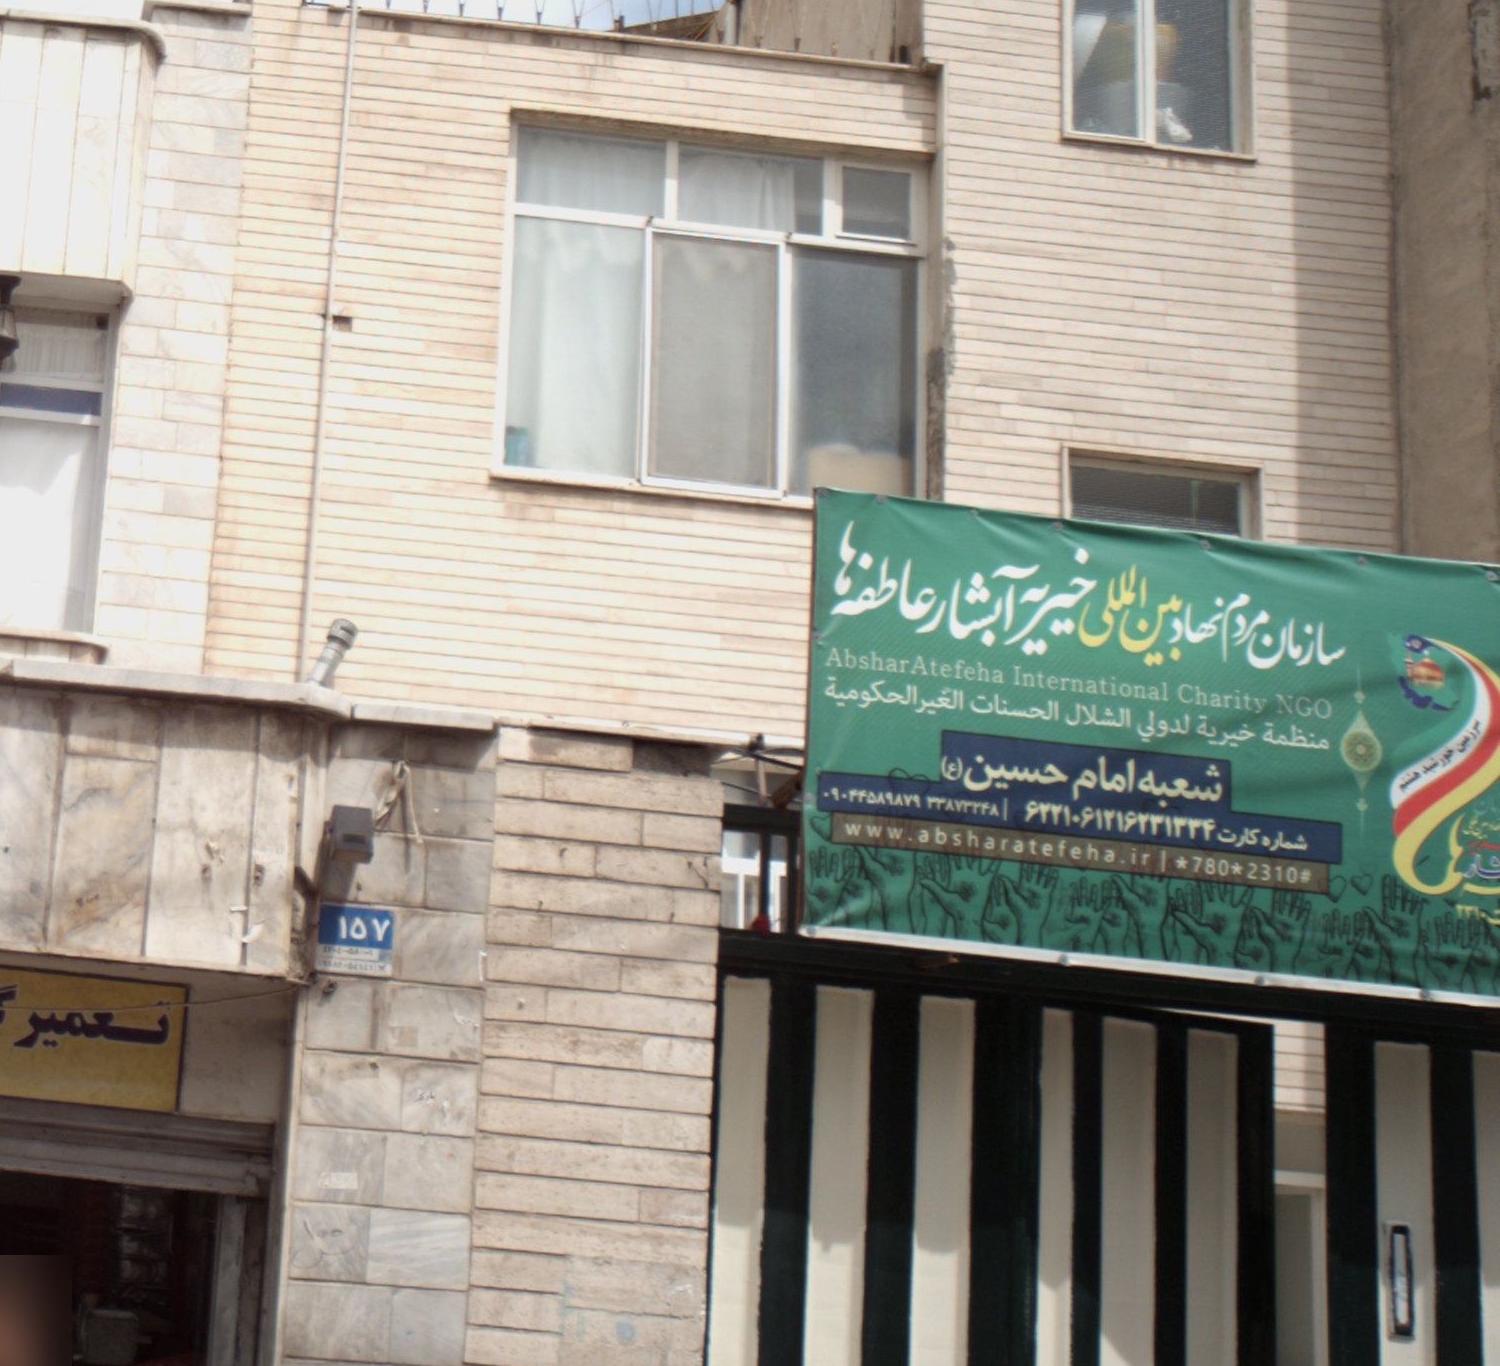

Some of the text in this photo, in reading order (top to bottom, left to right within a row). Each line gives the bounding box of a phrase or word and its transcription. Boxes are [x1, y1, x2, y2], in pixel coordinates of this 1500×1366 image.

[1247, 615, 1346, 670] سازمان
[825, 647, 1333, 719] AbsharAtefeha International Charity NGO
[1072, 755, 1136, 801] امام
[1137, 763, 1223, 808] شعبه
[844, 822, 1151, 866] www.absharatefeha.ir
[340, 915, 391, 942] ۱۵۷
